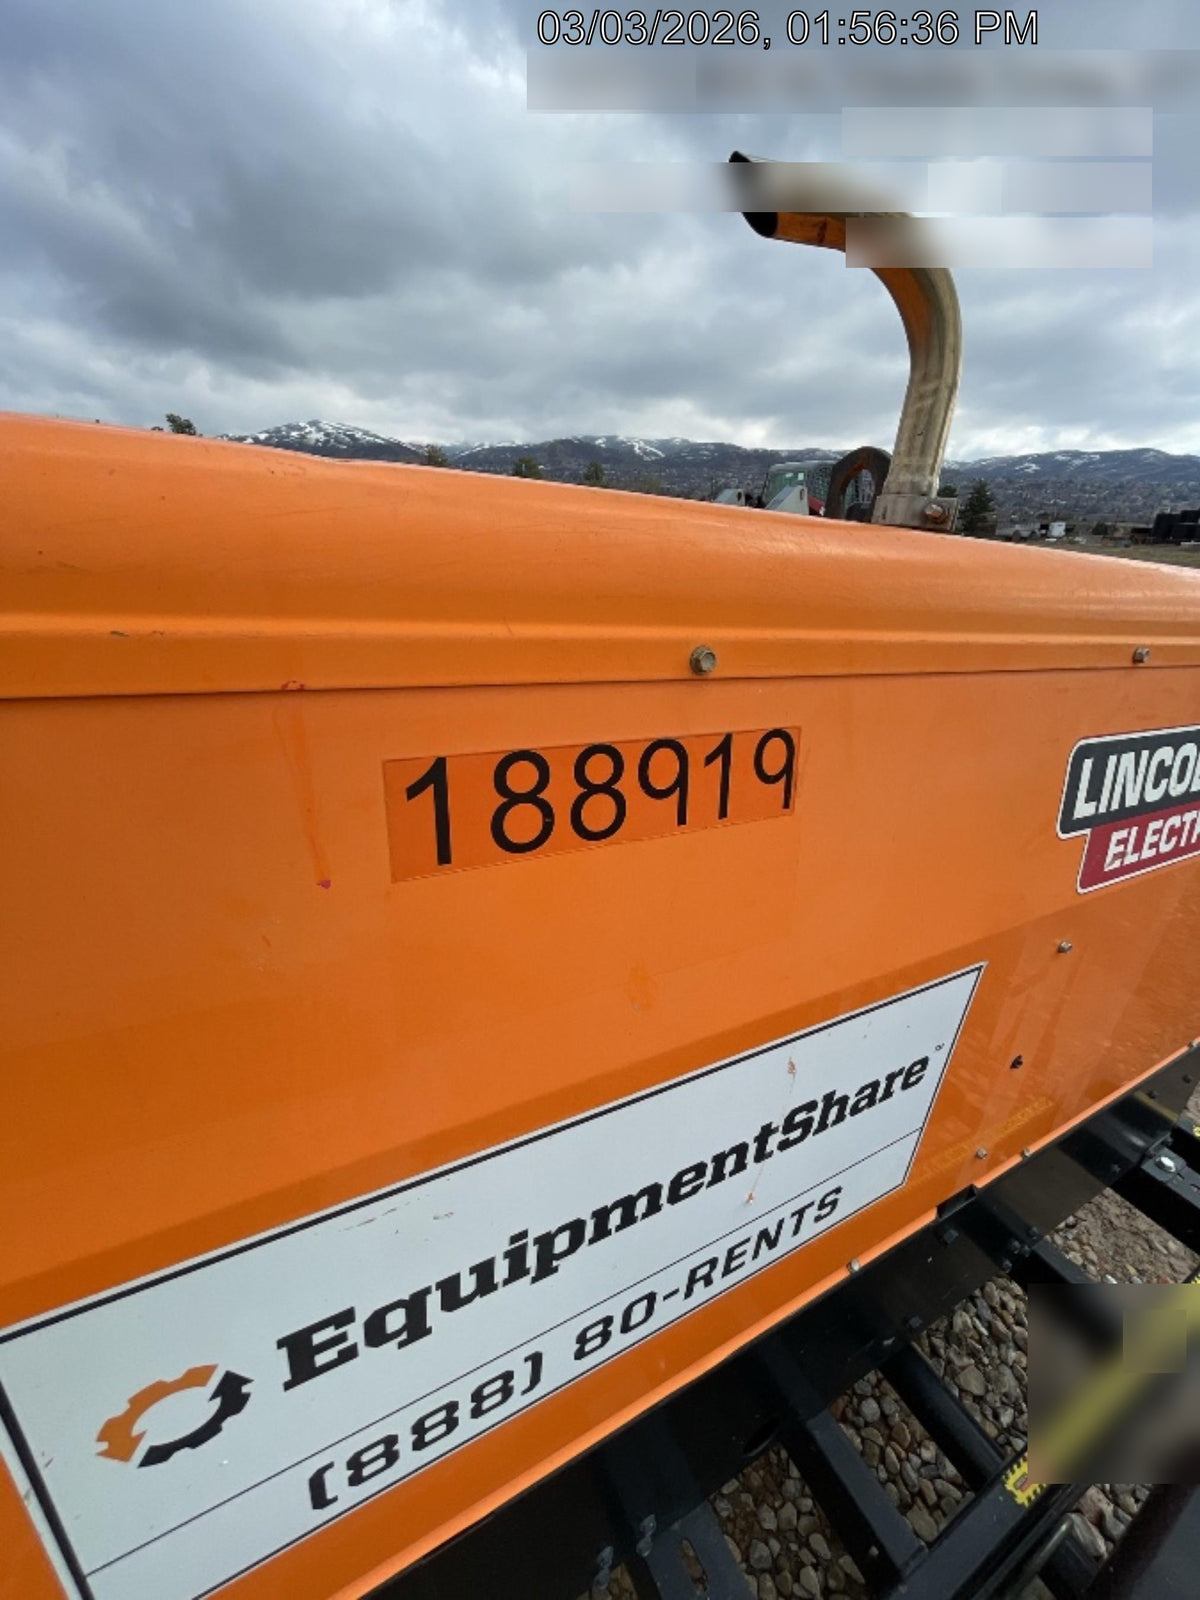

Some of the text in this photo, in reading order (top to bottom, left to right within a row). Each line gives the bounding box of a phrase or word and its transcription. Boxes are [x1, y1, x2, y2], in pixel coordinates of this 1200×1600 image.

[405, 728, 796, 866] 188919
[277, 1055, 929, 1390] EquipmentShare
[308, 1186, 844, 1511] (888) 80-RENTS
